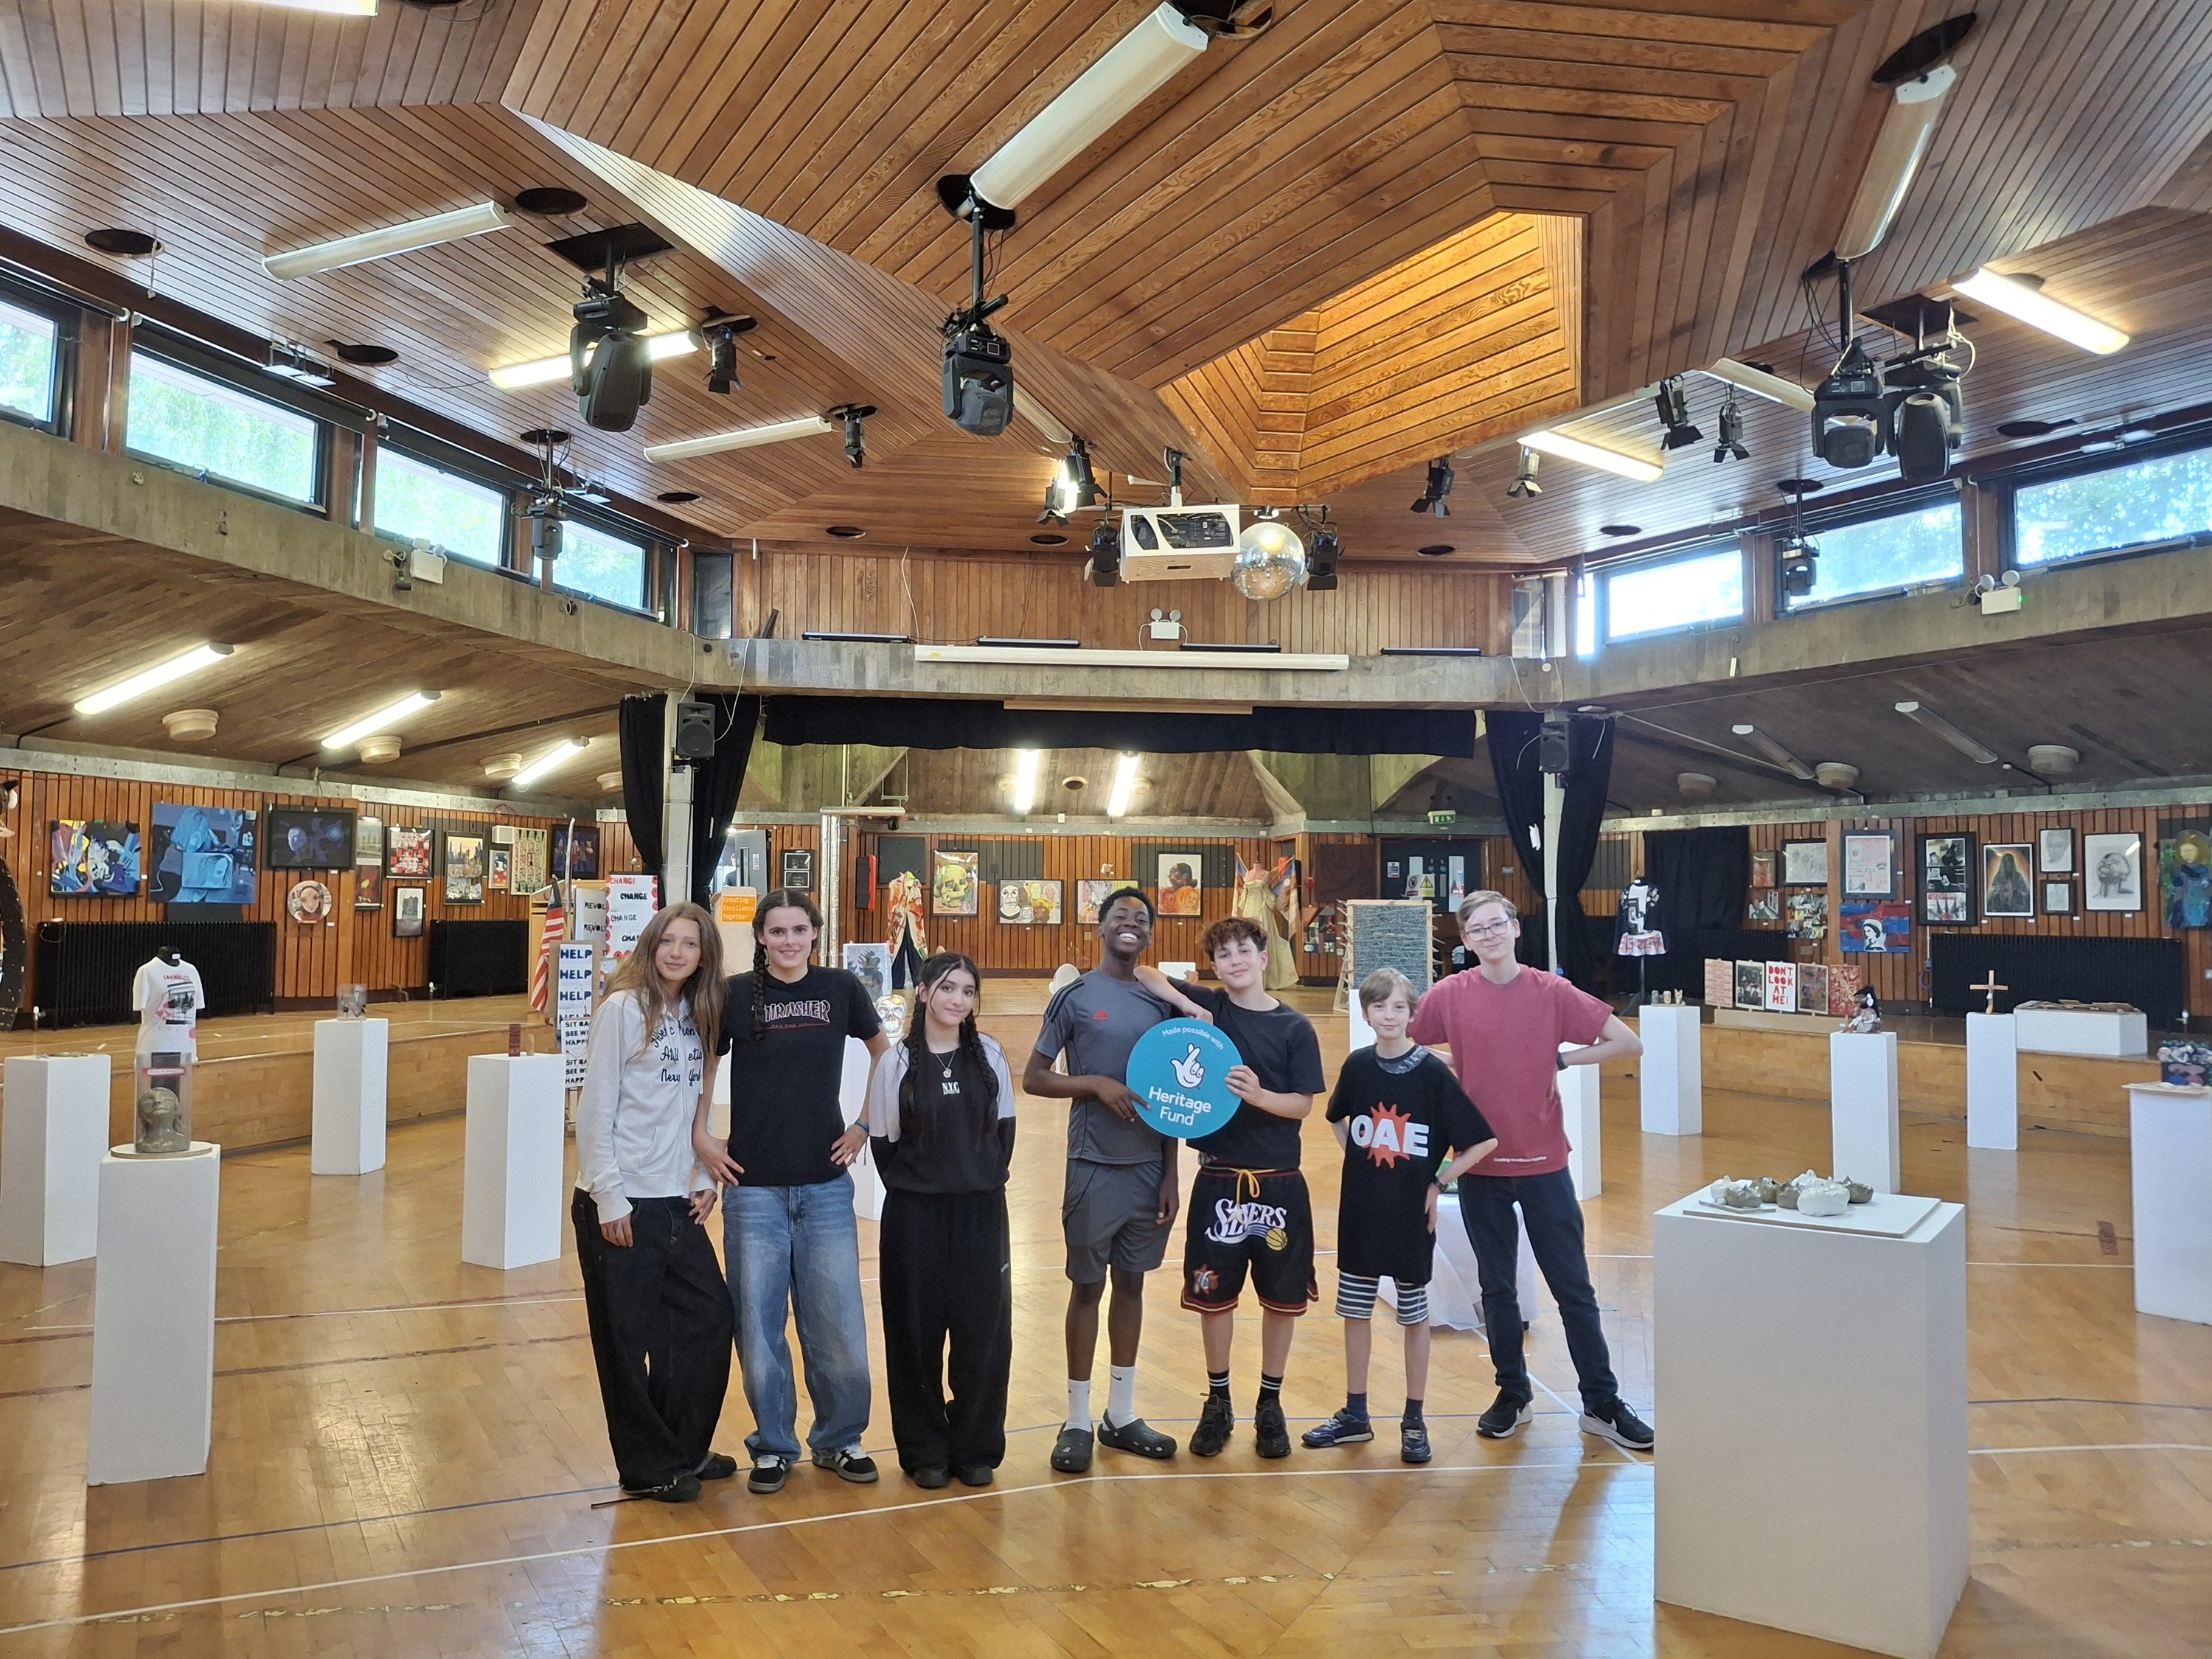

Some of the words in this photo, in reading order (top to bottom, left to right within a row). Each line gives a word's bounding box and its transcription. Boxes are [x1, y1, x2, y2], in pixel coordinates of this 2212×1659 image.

[585, 901, 606, 910] REVOL
[560, 949, 593, 959] HELP
[560, 970, 592, 980] HELP
[1768, 975, 1793, 987] LOOK
[560, 991, 592, 1001] HELP
[1773, 985, 1787, 995] AT
[751, 999, 830, 1023] HRASHER
[1162, 1026, 1181, 1037] Made
[1182, 1026, 1211, 1040] possible
[1211, 1036, 1224, 1050] with
[661, 1068, 681, 1082] New
[1148, 1086, 1212, 1114] Heritage
[1159, 1105, 1194, 1126] Fund
[1351, 1114, 1430, 1157] OAE
